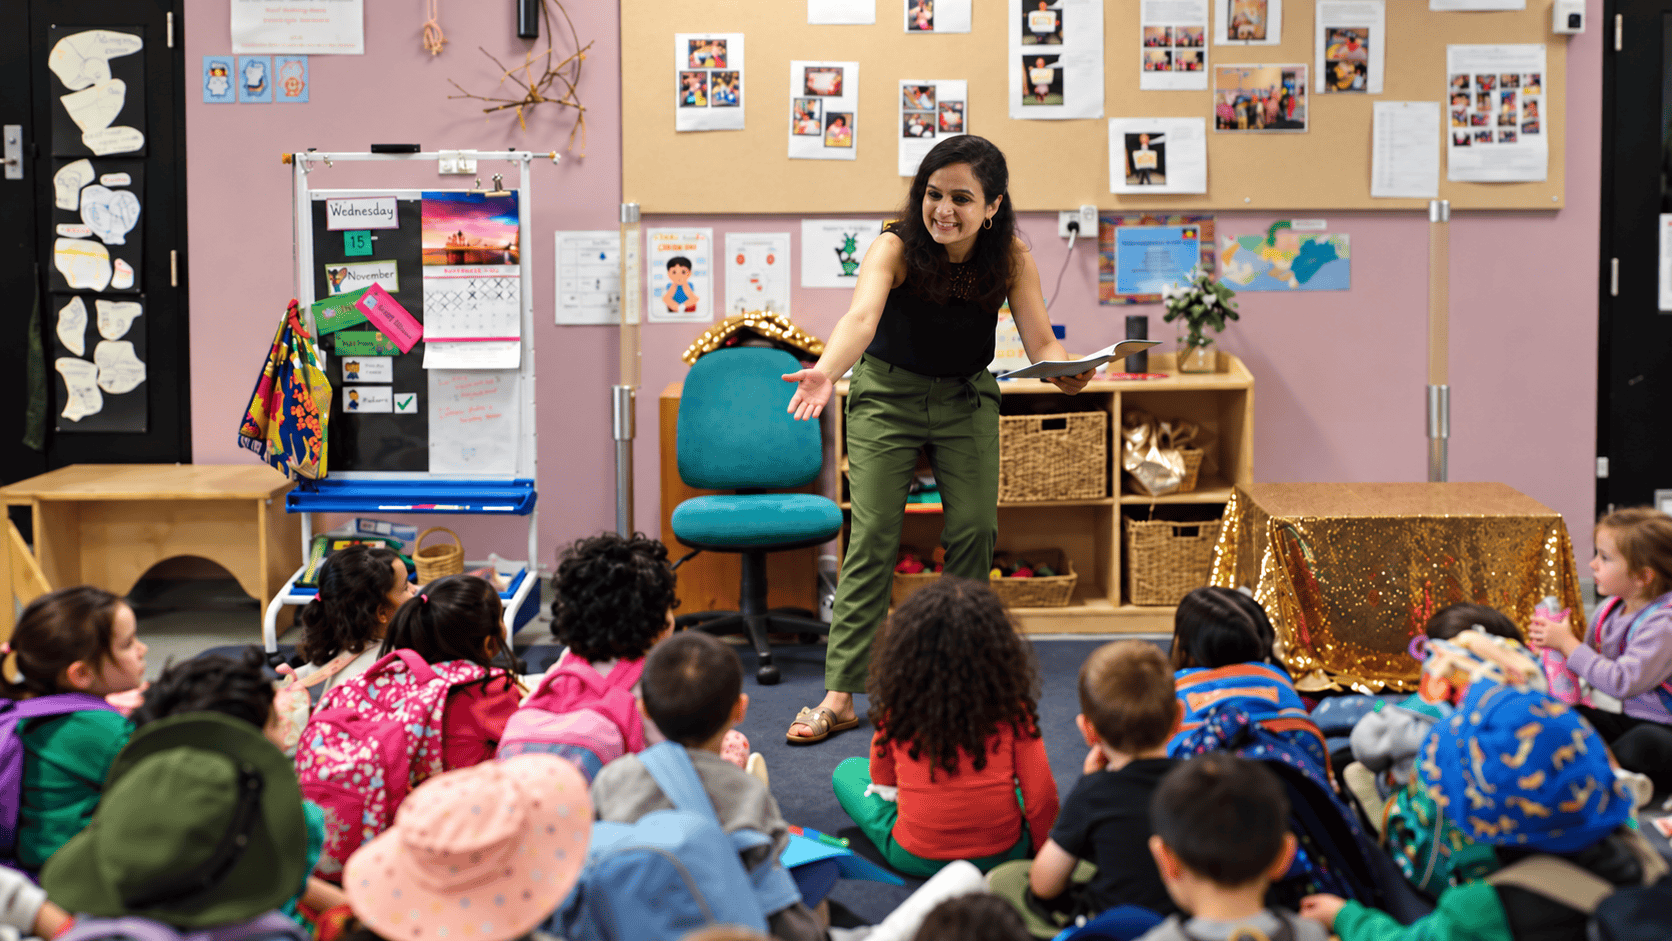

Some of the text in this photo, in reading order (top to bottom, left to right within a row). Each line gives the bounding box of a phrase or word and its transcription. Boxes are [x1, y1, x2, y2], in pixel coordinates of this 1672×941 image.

[330, 202, 393, 220] Wednesday
[350, 235, 365, 248] 15
[347, 269, 394, 281] November
